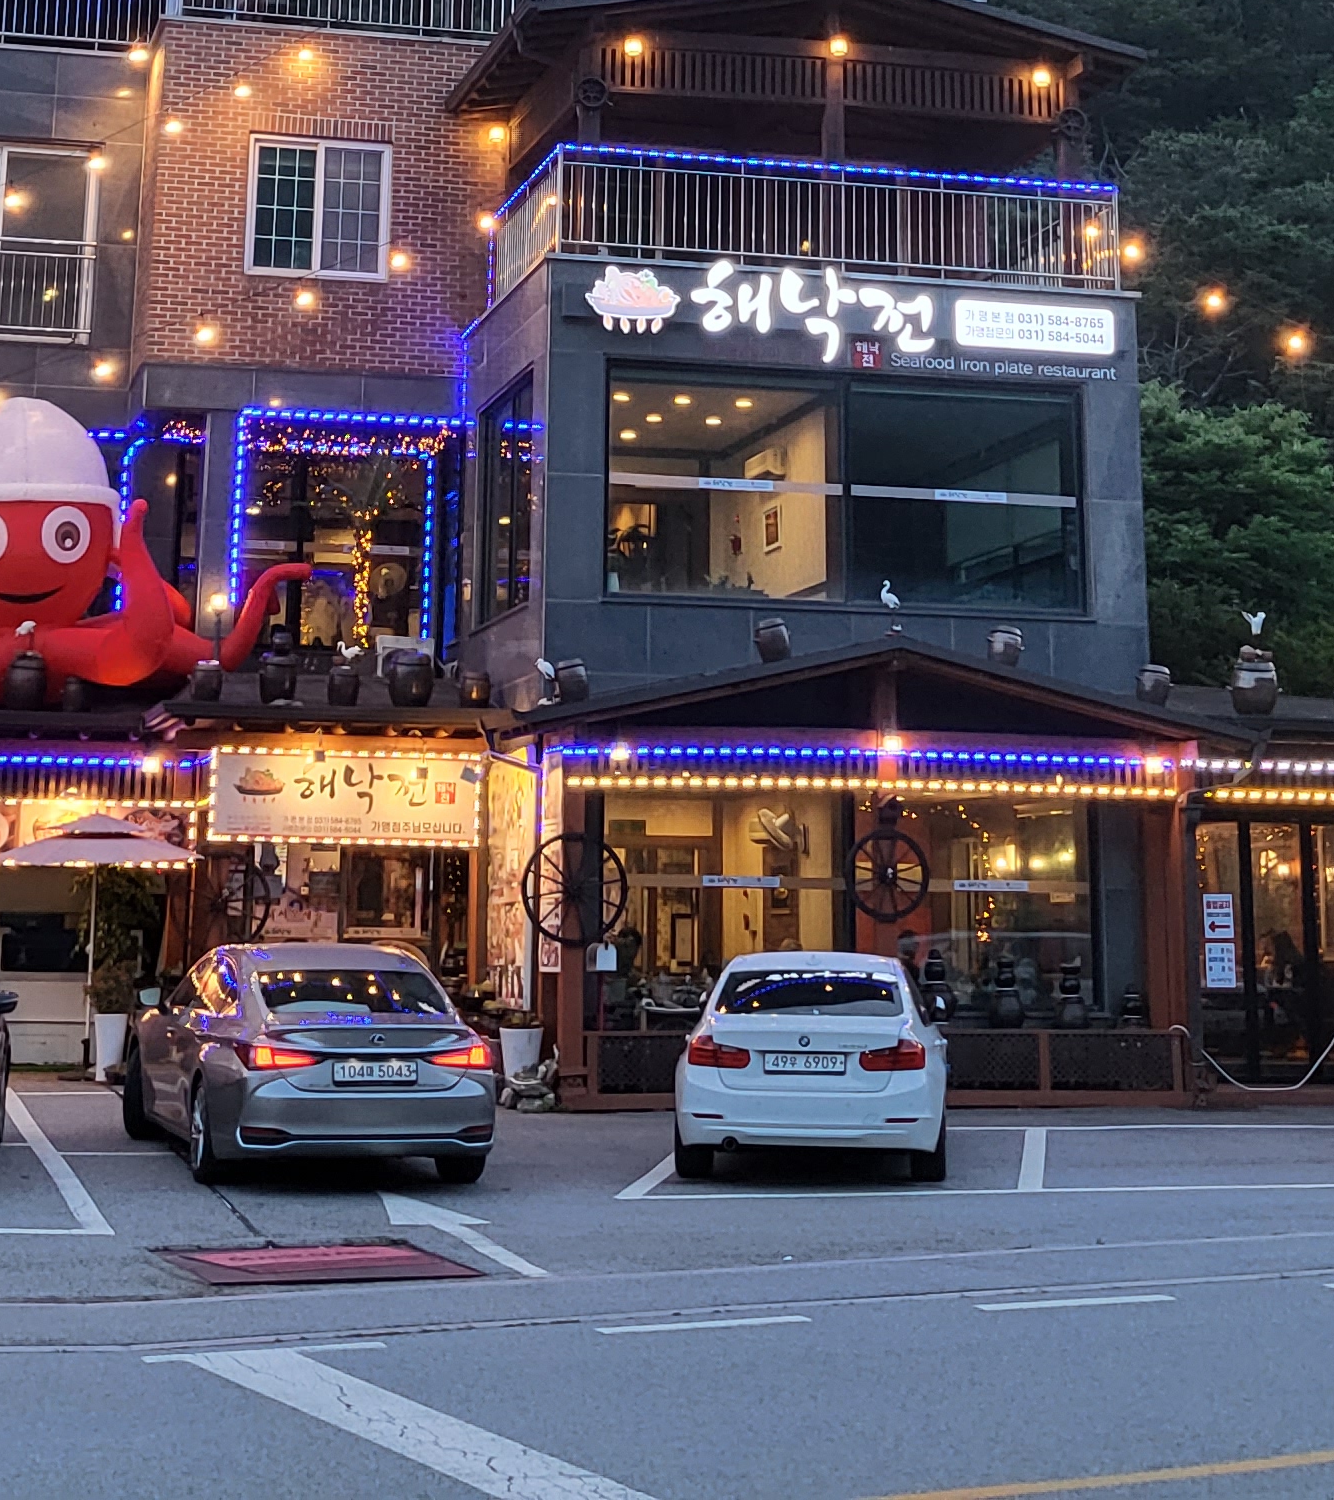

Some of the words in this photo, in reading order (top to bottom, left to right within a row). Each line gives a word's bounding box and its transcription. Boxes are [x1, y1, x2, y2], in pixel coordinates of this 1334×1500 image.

[690, 259, 937, 363] 해낙전
[1047, 314, 1104, 329] 584-8765
[1047, 330, 1104, 345] 584-5044
[890, 353, 955, 370] Seafood
[994, 358, 1034, 377] plate
[1037, 364, 1117, 381] restaurant
[293, 762, 428, 815] 해낙전
[803, 1056, 838, 1069] 6909
[378, 1064, 413, 1078] 5043
